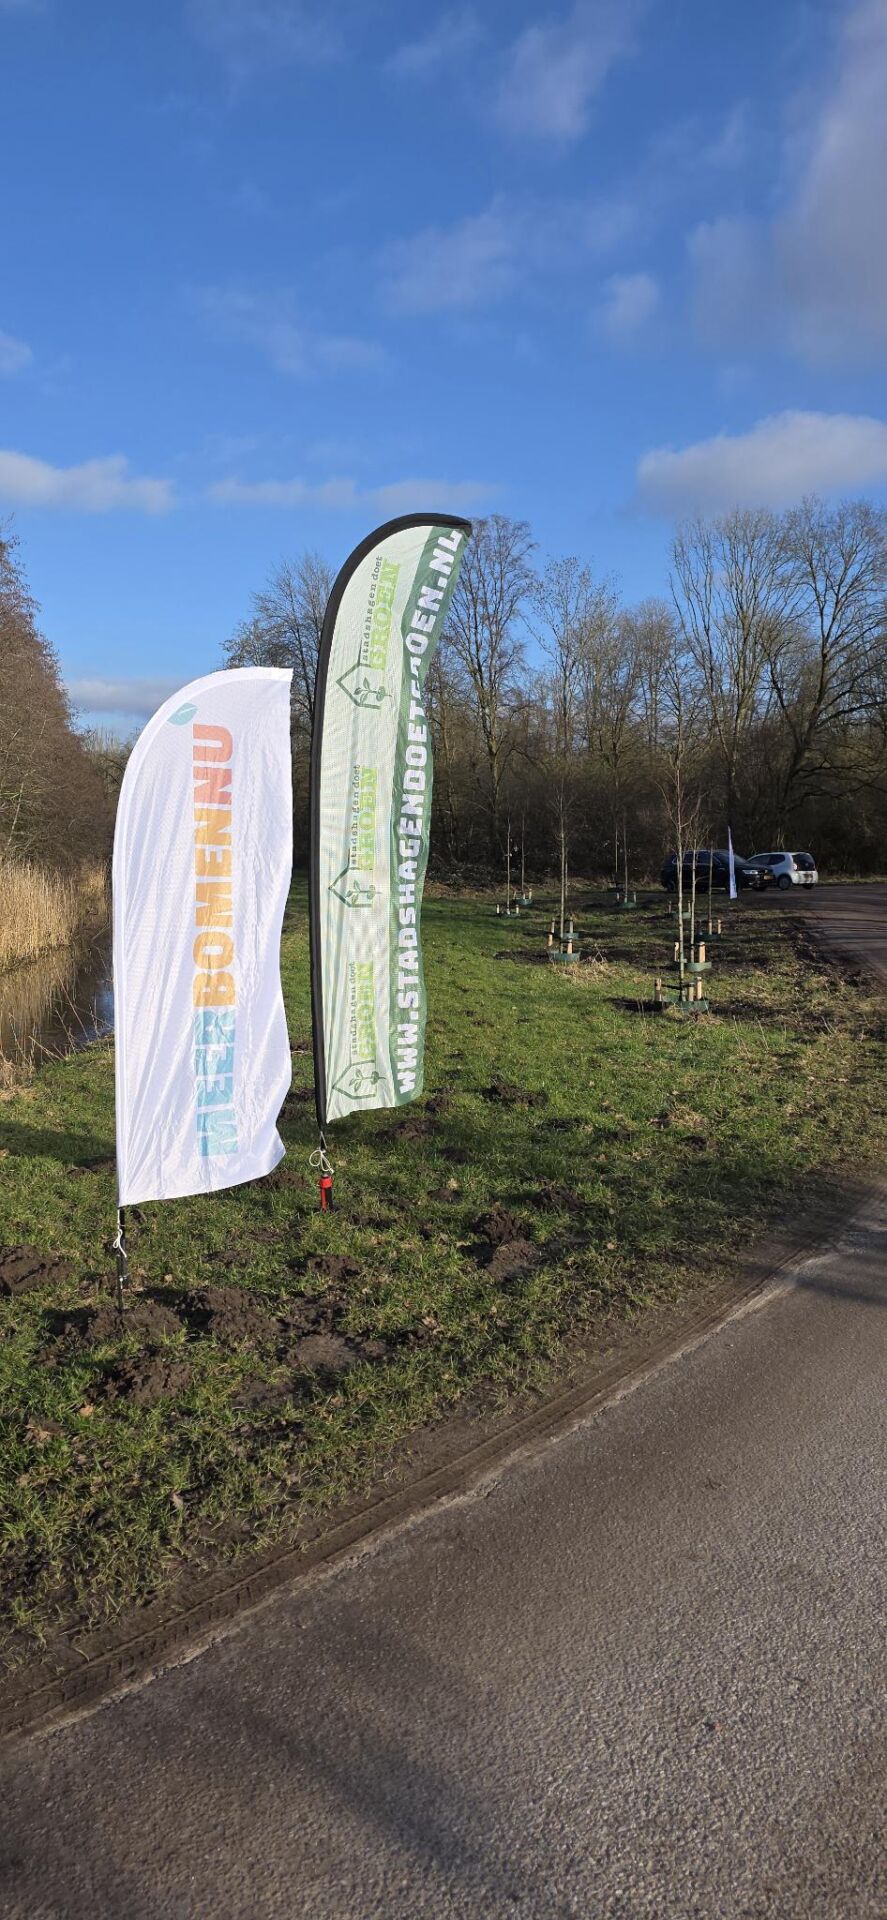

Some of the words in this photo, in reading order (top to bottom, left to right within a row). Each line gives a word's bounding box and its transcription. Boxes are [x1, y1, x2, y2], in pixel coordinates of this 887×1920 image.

[361, 584, 376, 661] stadshagen
[372, 555, 383, 581] doet
[369, 558, 400, 671] GROEN
[351, 764, 360, 789] doet
[351, 791, 360, 866] stadshagen
[359, 766, 377, 870] GROEN
